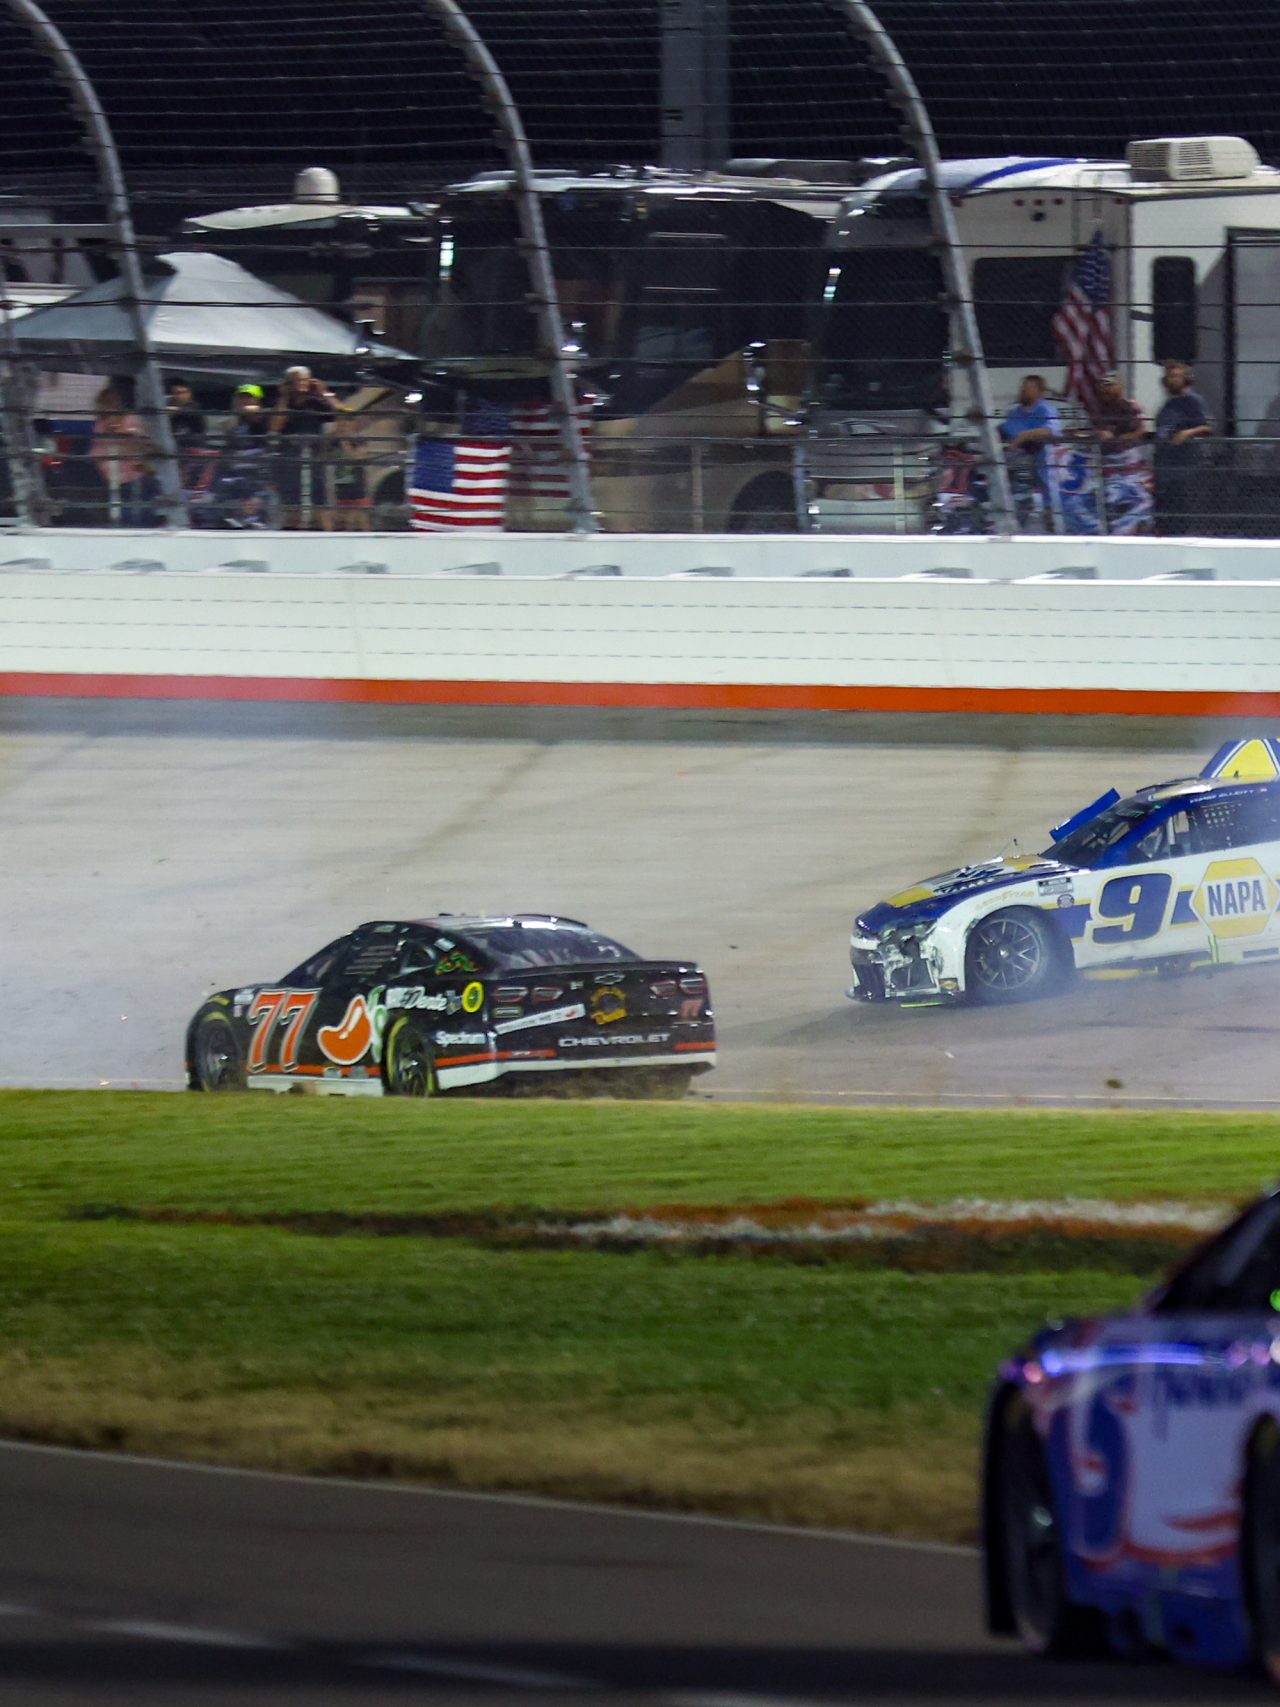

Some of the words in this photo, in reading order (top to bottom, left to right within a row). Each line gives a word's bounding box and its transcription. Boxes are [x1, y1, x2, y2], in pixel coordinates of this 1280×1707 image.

[1091, 871, 1174, 945] 9
[1207, 880, 1266, 917] NAPA
[246, 987, 323, 1073] 77
[436, 1030, 486, 1048] Spectrum
[558, 1033, 671, 1048] CHEVROLET
